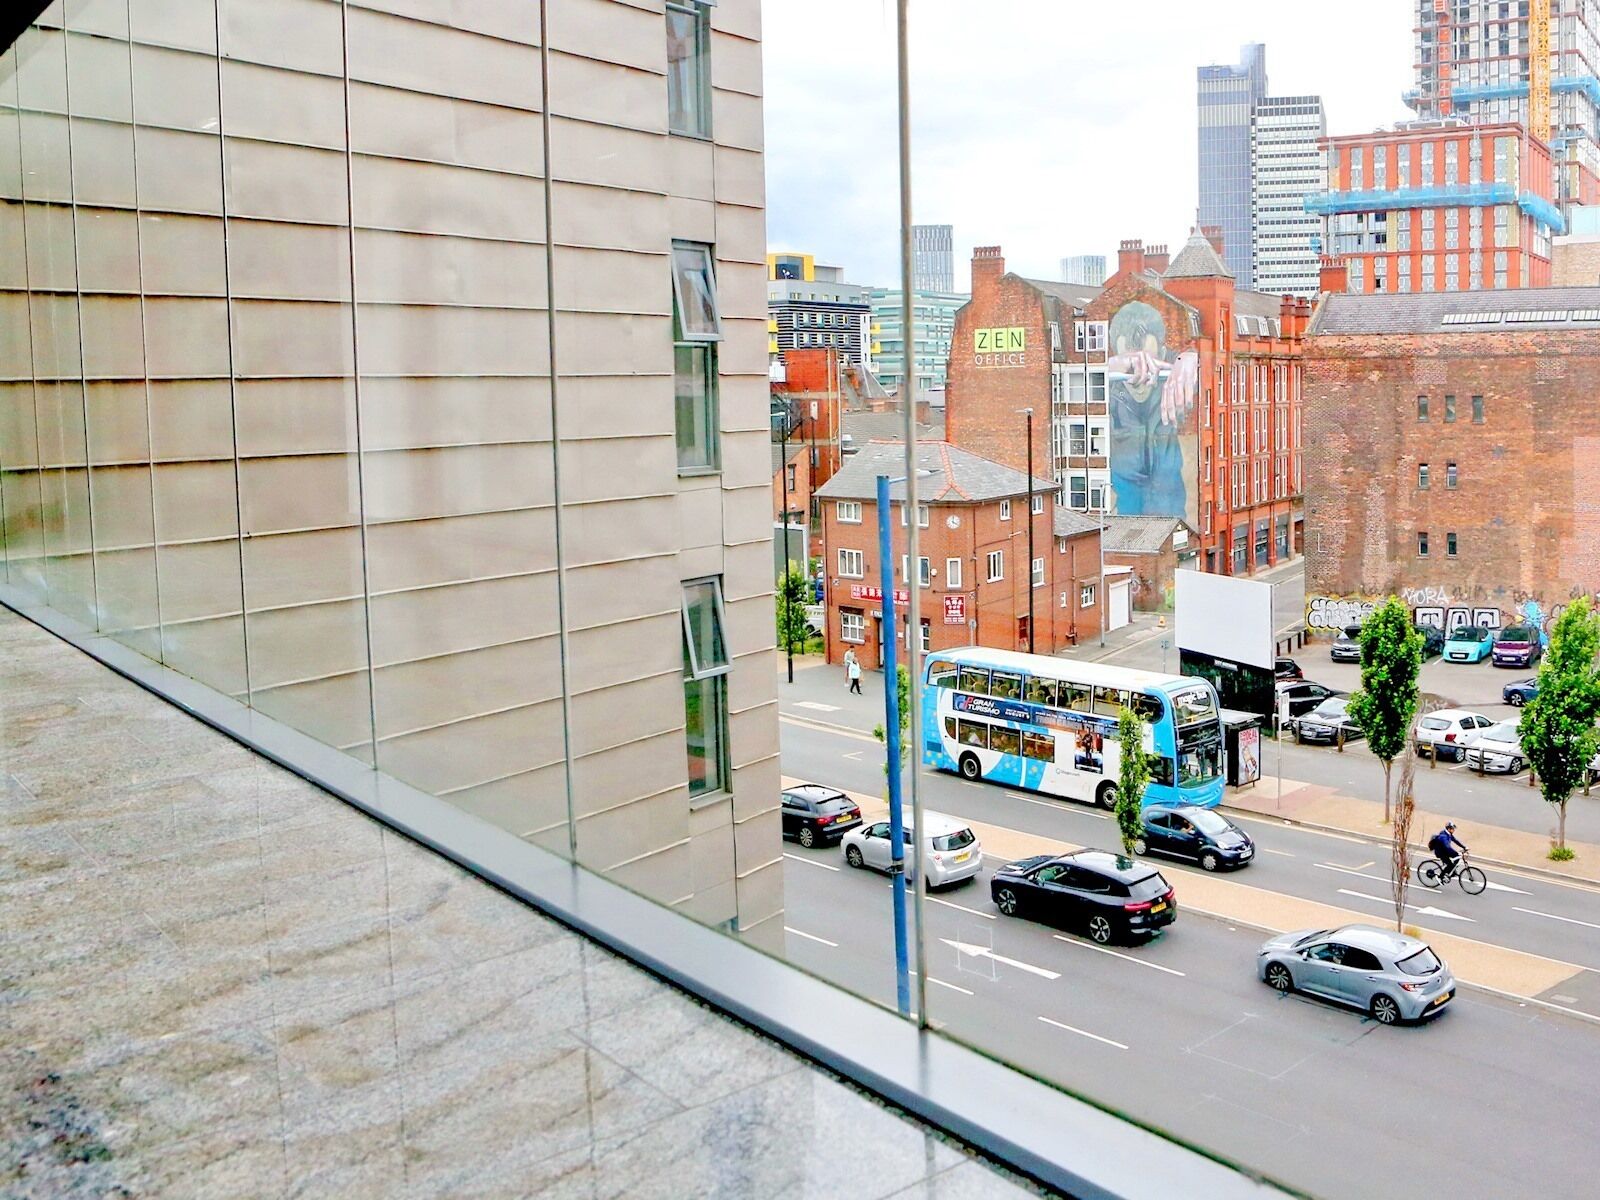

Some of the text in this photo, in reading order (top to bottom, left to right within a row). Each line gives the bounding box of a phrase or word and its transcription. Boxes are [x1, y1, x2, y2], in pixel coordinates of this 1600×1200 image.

[978, 331, 1022, 349] ZEN
[975, 353, 1025, 366] OFFICE
[973, 698, 995, 708] GRAN
[967, 704, 1001, 716] TURISMO
